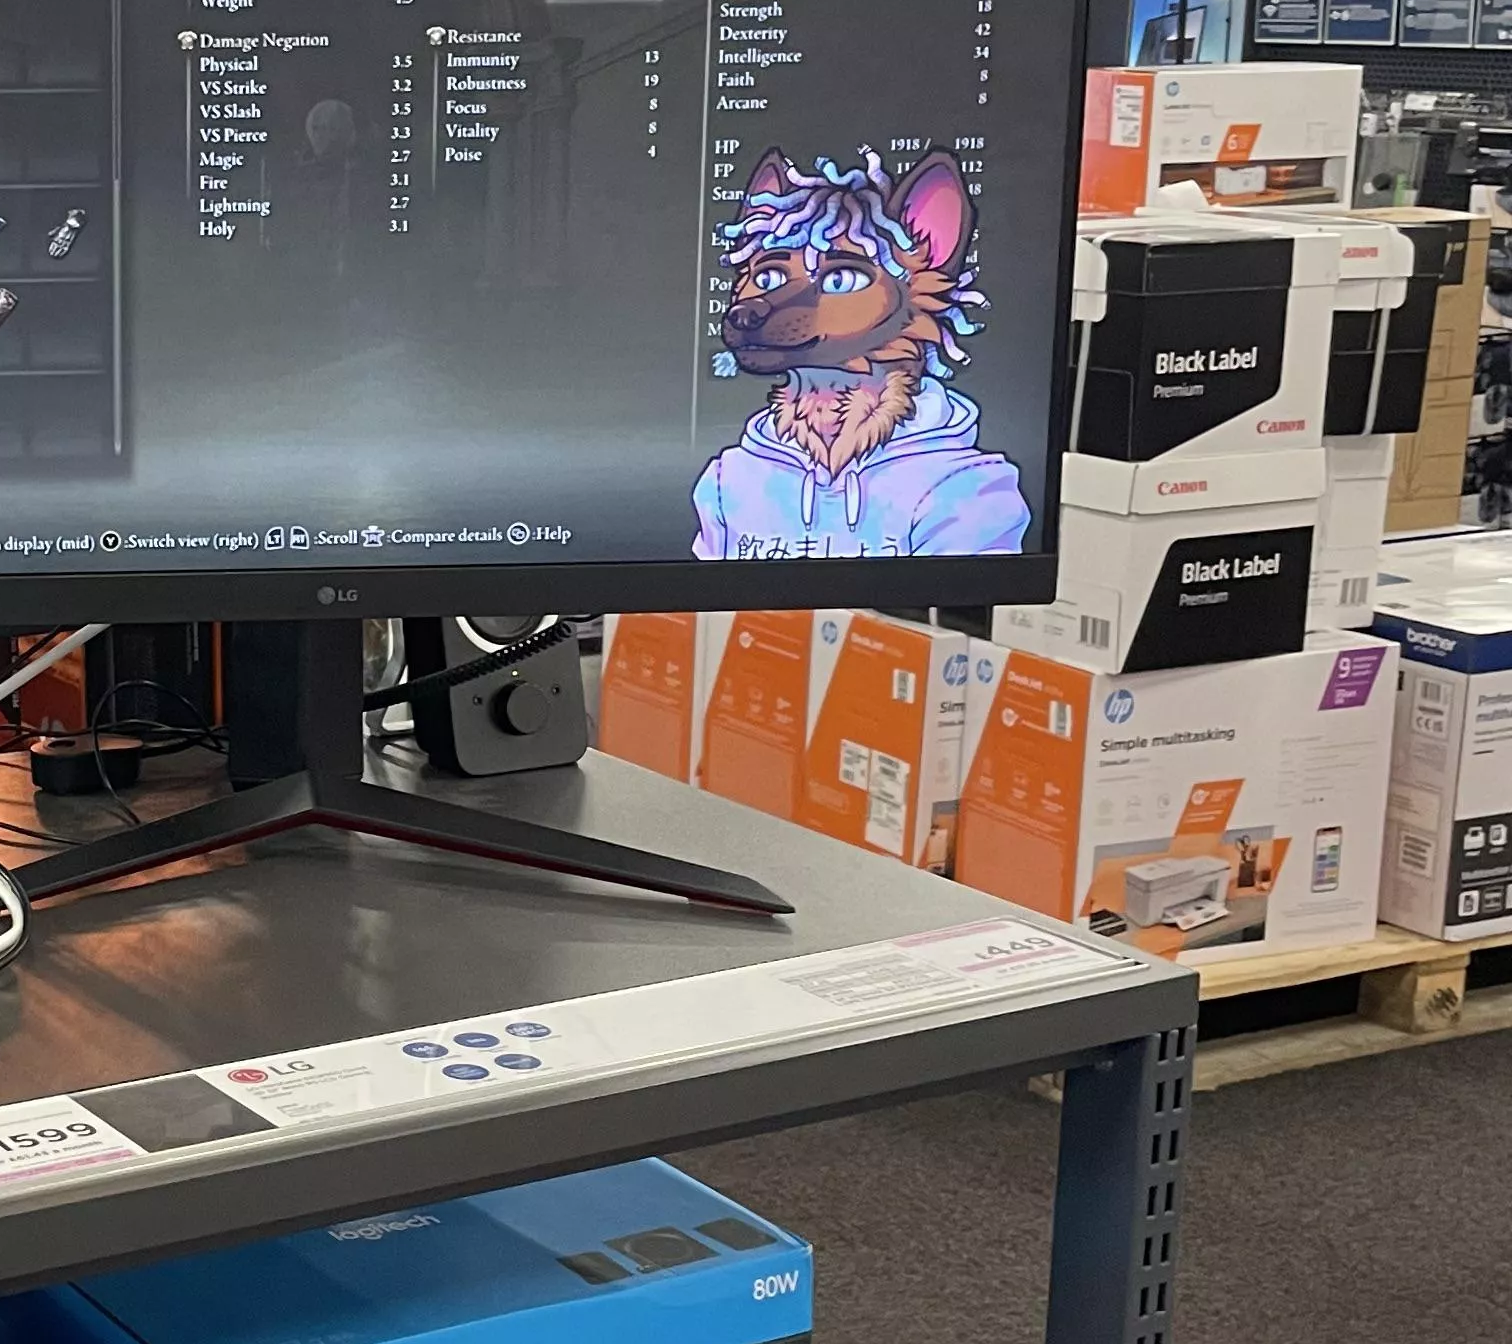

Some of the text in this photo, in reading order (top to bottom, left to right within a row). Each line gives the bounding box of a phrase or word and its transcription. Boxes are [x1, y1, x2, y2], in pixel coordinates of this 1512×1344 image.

[720, 0, 992, 21] Strength 18
[199, 32, 329, 51] Damage Negation
[447, 28, 522, 44] Resistance
[719, 23, 991, 43] Dexterity 42
[199, 56, 412, 74] Physical 3.5
[446, 50, 660, 70] Immunity 13
[718, 46, 990, 67] Intelligence 34
[199, 79, 412, 95] VS Strike 3.2
[446, 74, 660, 91] Robustness 19
[717, 72, 755, 87] Faith
[199, 103, 411, 119] VS Slash 3.5
[446, 98, 658, 115] Focus 8
[716, 96, 768, 110] Arcane
[199, 126, 411, 143] VS Pierce 3.3
[445, 122, 657, 142] Vitality 8
[445, 145, 656, 162] Poise 4
[715, 138, 985, 154] HP 1918 1918
[199, 150, 411, 169] Magic 2.7
[714, 164, 734, 178] FP
[199, 173, 409, 190] Fire 3.1
[199, 197, 410, 216] Lightning 2.7
[199, 220, 408, 238] Holy 3.1
[1156, 346, 1258, 376] Black Label
[1153, 382, 1204, 399] Premium
[1256, 419, 1305, 435] Canon
[1157, 480, 1207, 497] Canon
[4, 536, 53, 555] display
[56, 535, 95, 552] (mid)
[178, 534, 210, 548] view
[213, 531, 259, 550] (right)
[458, 529, 503, 543] details
[1181, 553, 1280, 583] Black Label
[337, 589, 358, 602] LG
[1179, 589, 1229, 607] Premium
[1405, 627, 1457, 654] brother
[1339, 657, 1352, 678] 9
[1100, 727, 1236, 753] Simple multitasking
[269, 1060, 315, 1077] LG
[330, 1214, 440, 1242] logitech
[753, 1271, 799, 1300] 80W
